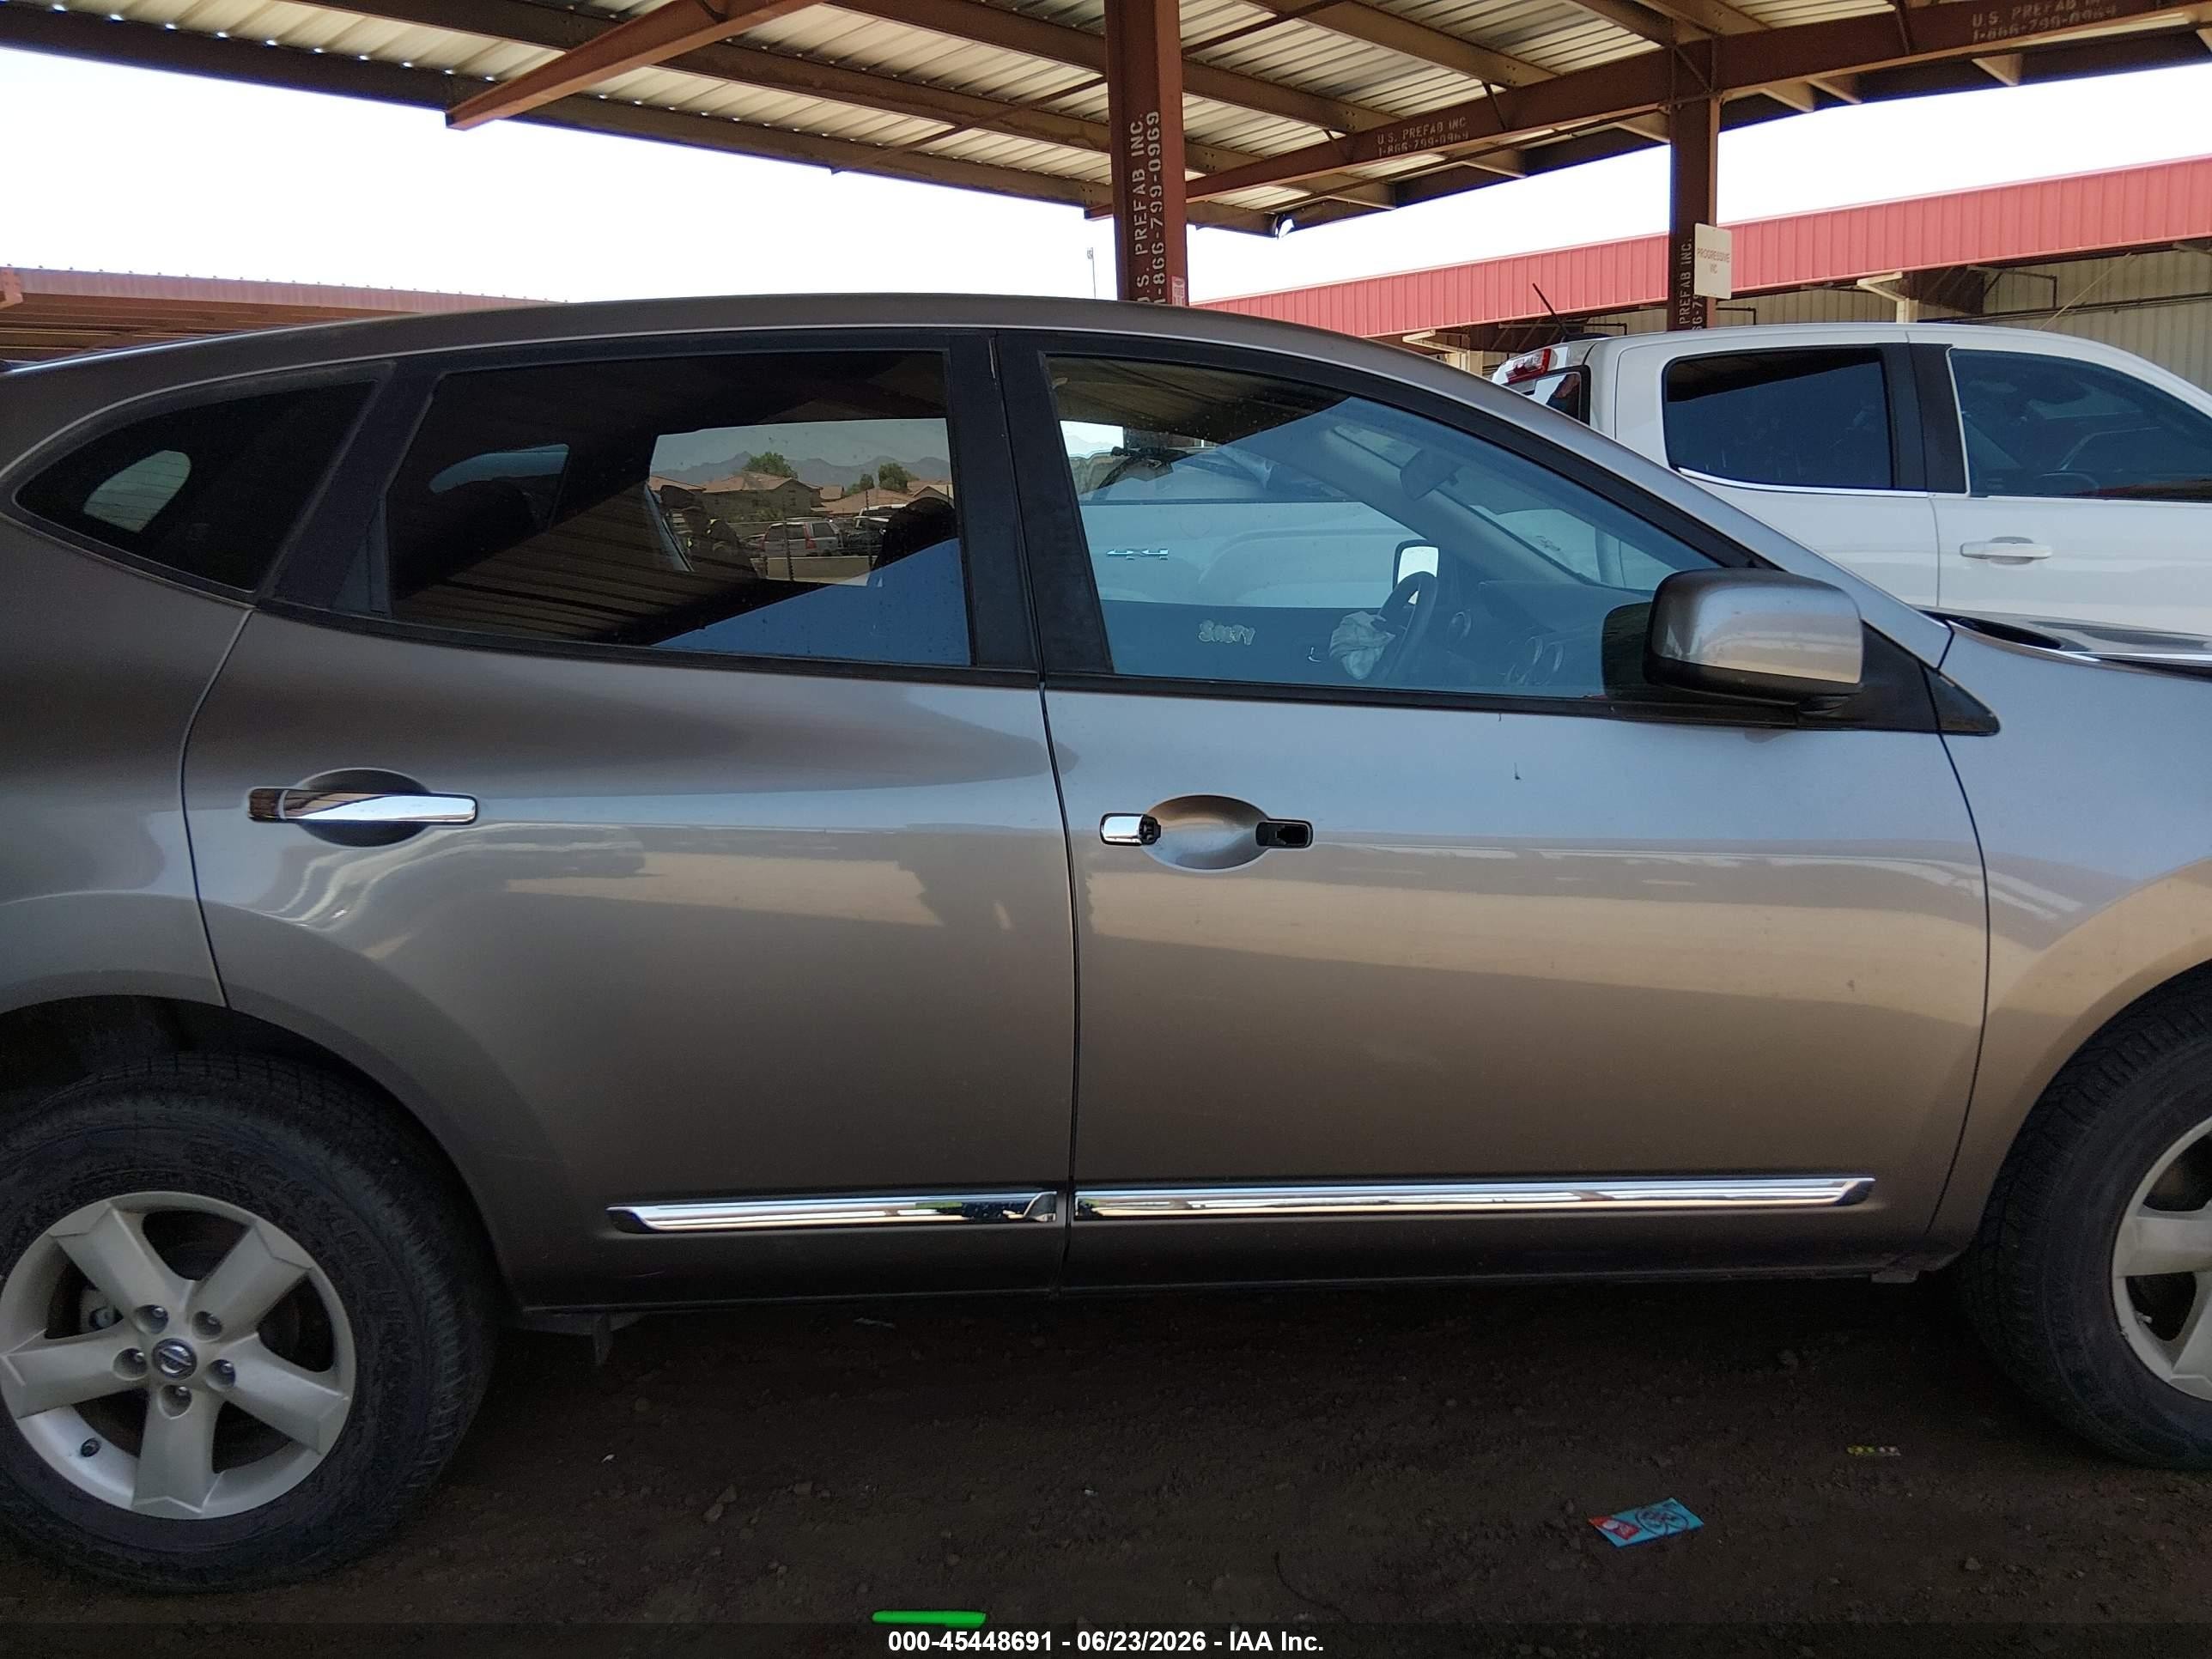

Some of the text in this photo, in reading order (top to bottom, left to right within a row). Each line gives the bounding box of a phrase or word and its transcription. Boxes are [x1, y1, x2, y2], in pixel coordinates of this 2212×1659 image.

[1130, 112, 1145, 155] INC.
[1402, 122, 1443, 141] PREFAB
[1132, 167, 1148, 255] PREFAB
[1146, 111, 1166, 304] 1-866-799-0969
[1679, 238, 1692, 325] PREFAB INC.
